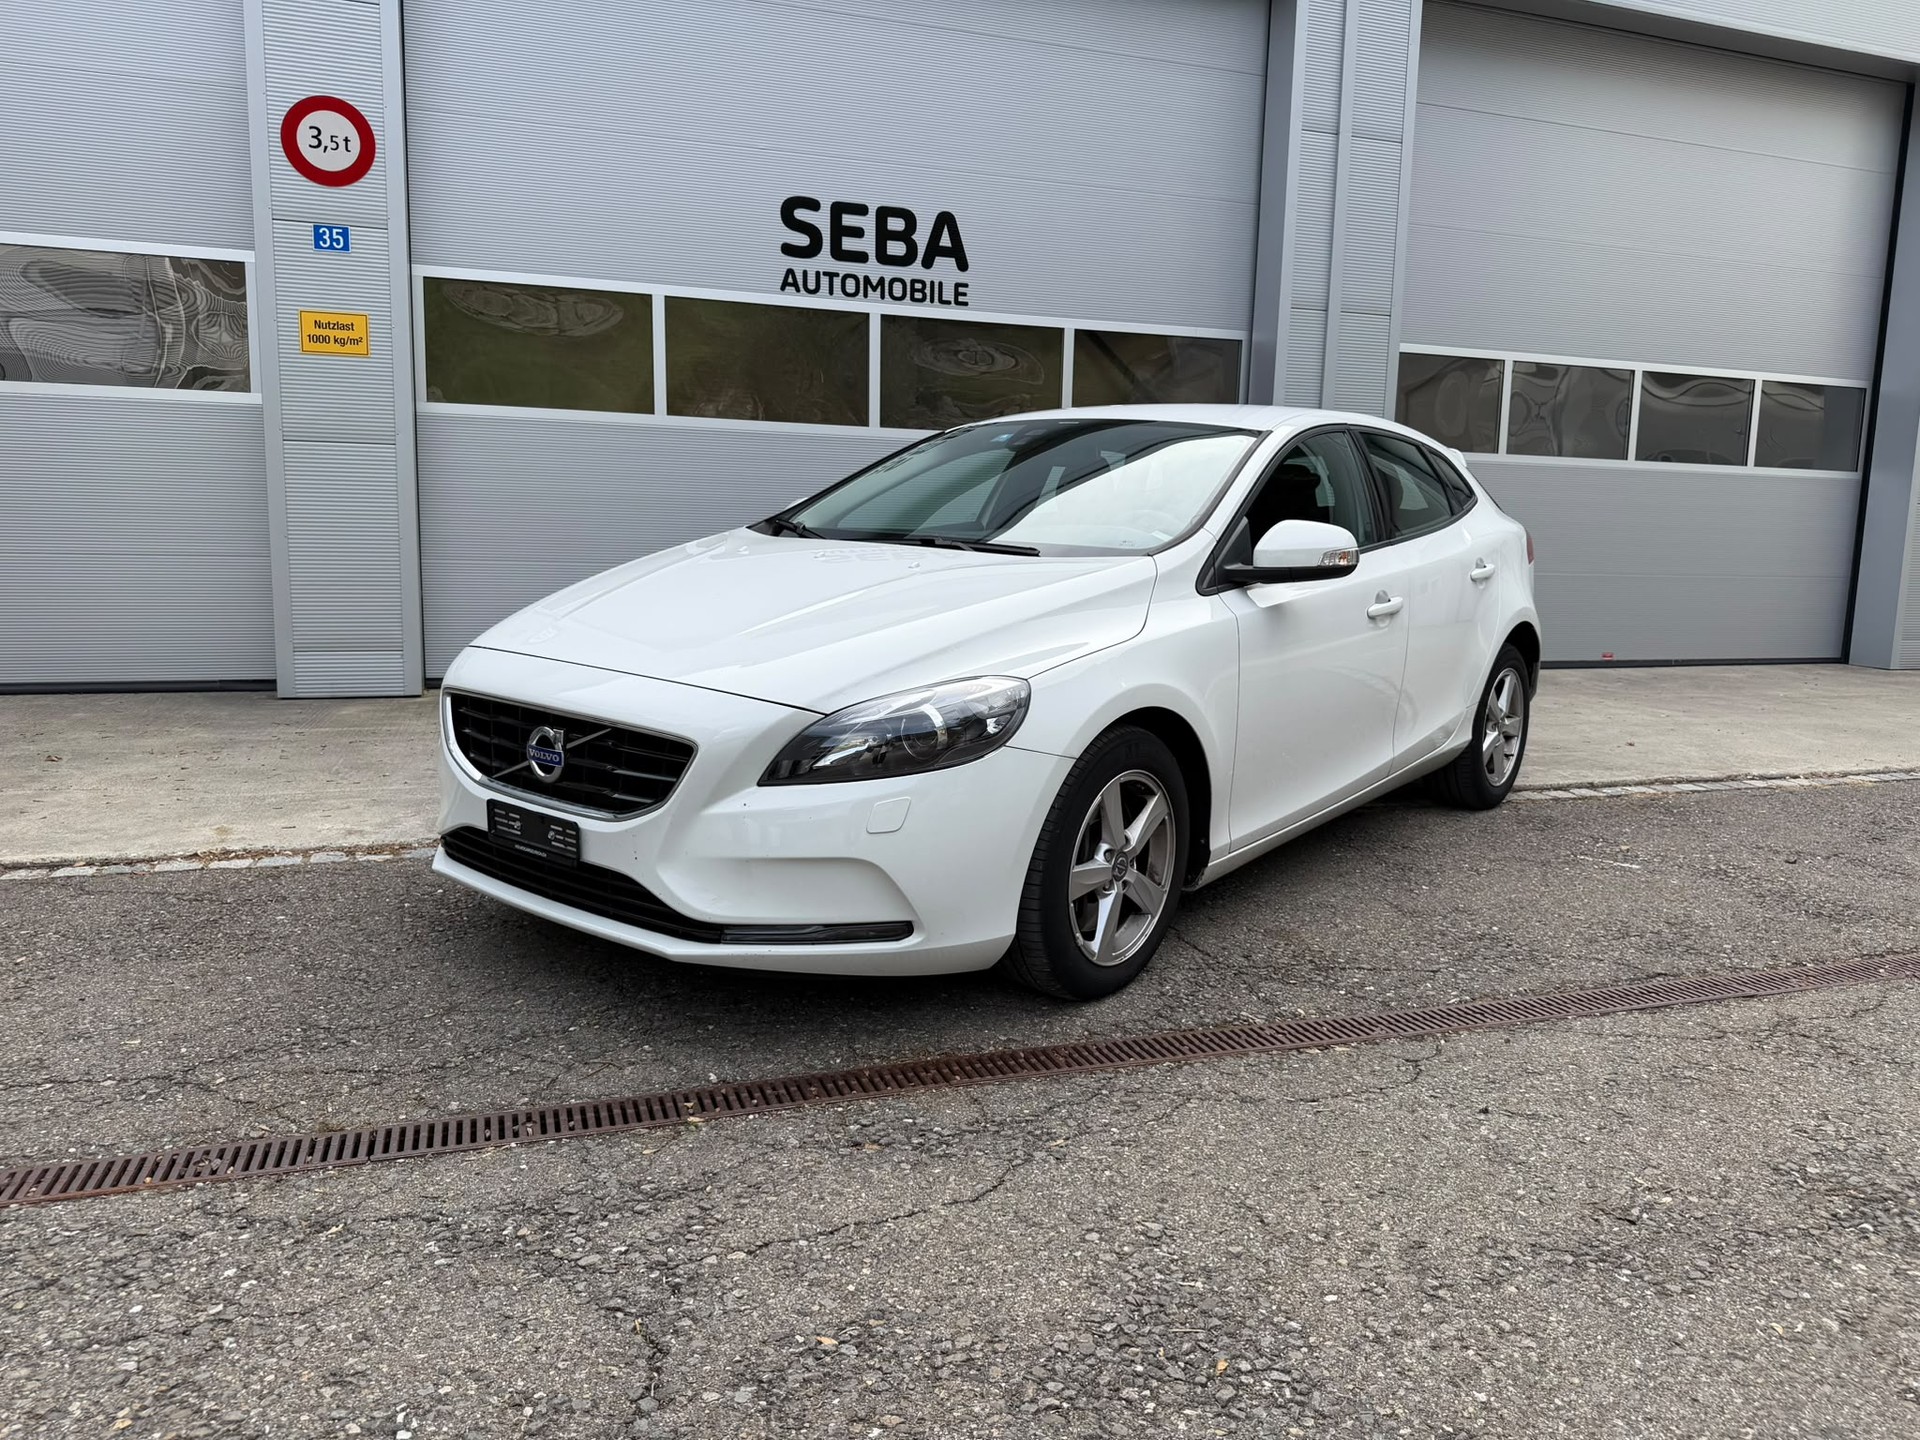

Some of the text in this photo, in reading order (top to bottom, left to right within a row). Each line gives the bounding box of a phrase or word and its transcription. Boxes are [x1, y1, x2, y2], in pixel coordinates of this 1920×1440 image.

[308, 125, 352, 154] 3,5 t
[318, 227, 345, 249] 35
[780, 195, 969, 272] SEBA
[780, 267, 969, 307] AUTOMOBILE
[314, 319, 355, 331] Nutzlast
[306, 333, 363, 347] 1000 kg/m²
[528, 748, 560, 762] VOLVO
